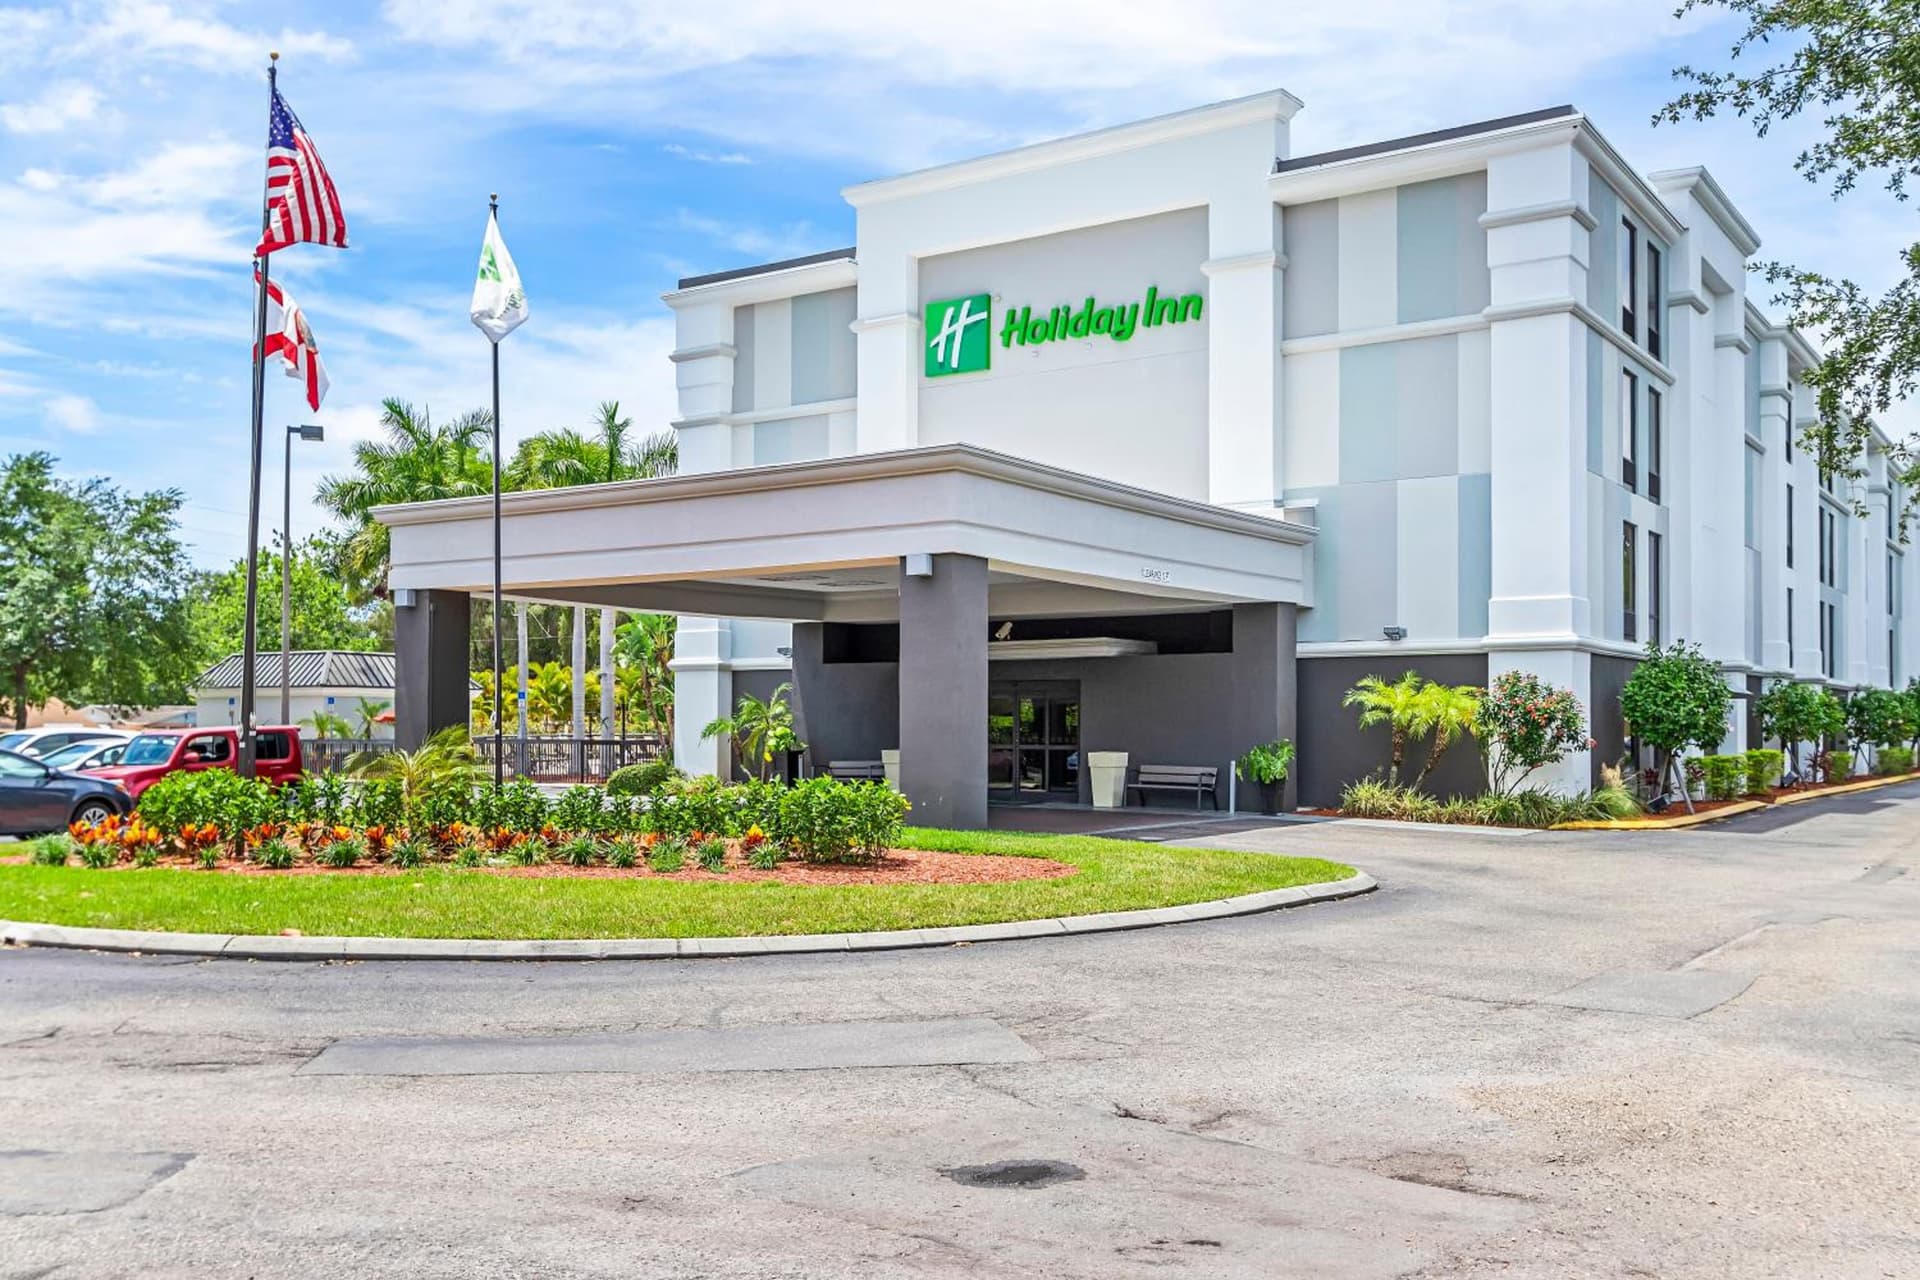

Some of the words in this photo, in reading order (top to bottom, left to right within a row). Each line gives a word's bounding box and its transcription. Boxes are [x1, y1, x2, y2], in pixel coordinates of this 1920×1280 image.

[930, 299, 987, 368] H
[1000, 296, 1139, 347] Holiday
[1142, 285, 1203, 328] Inn
